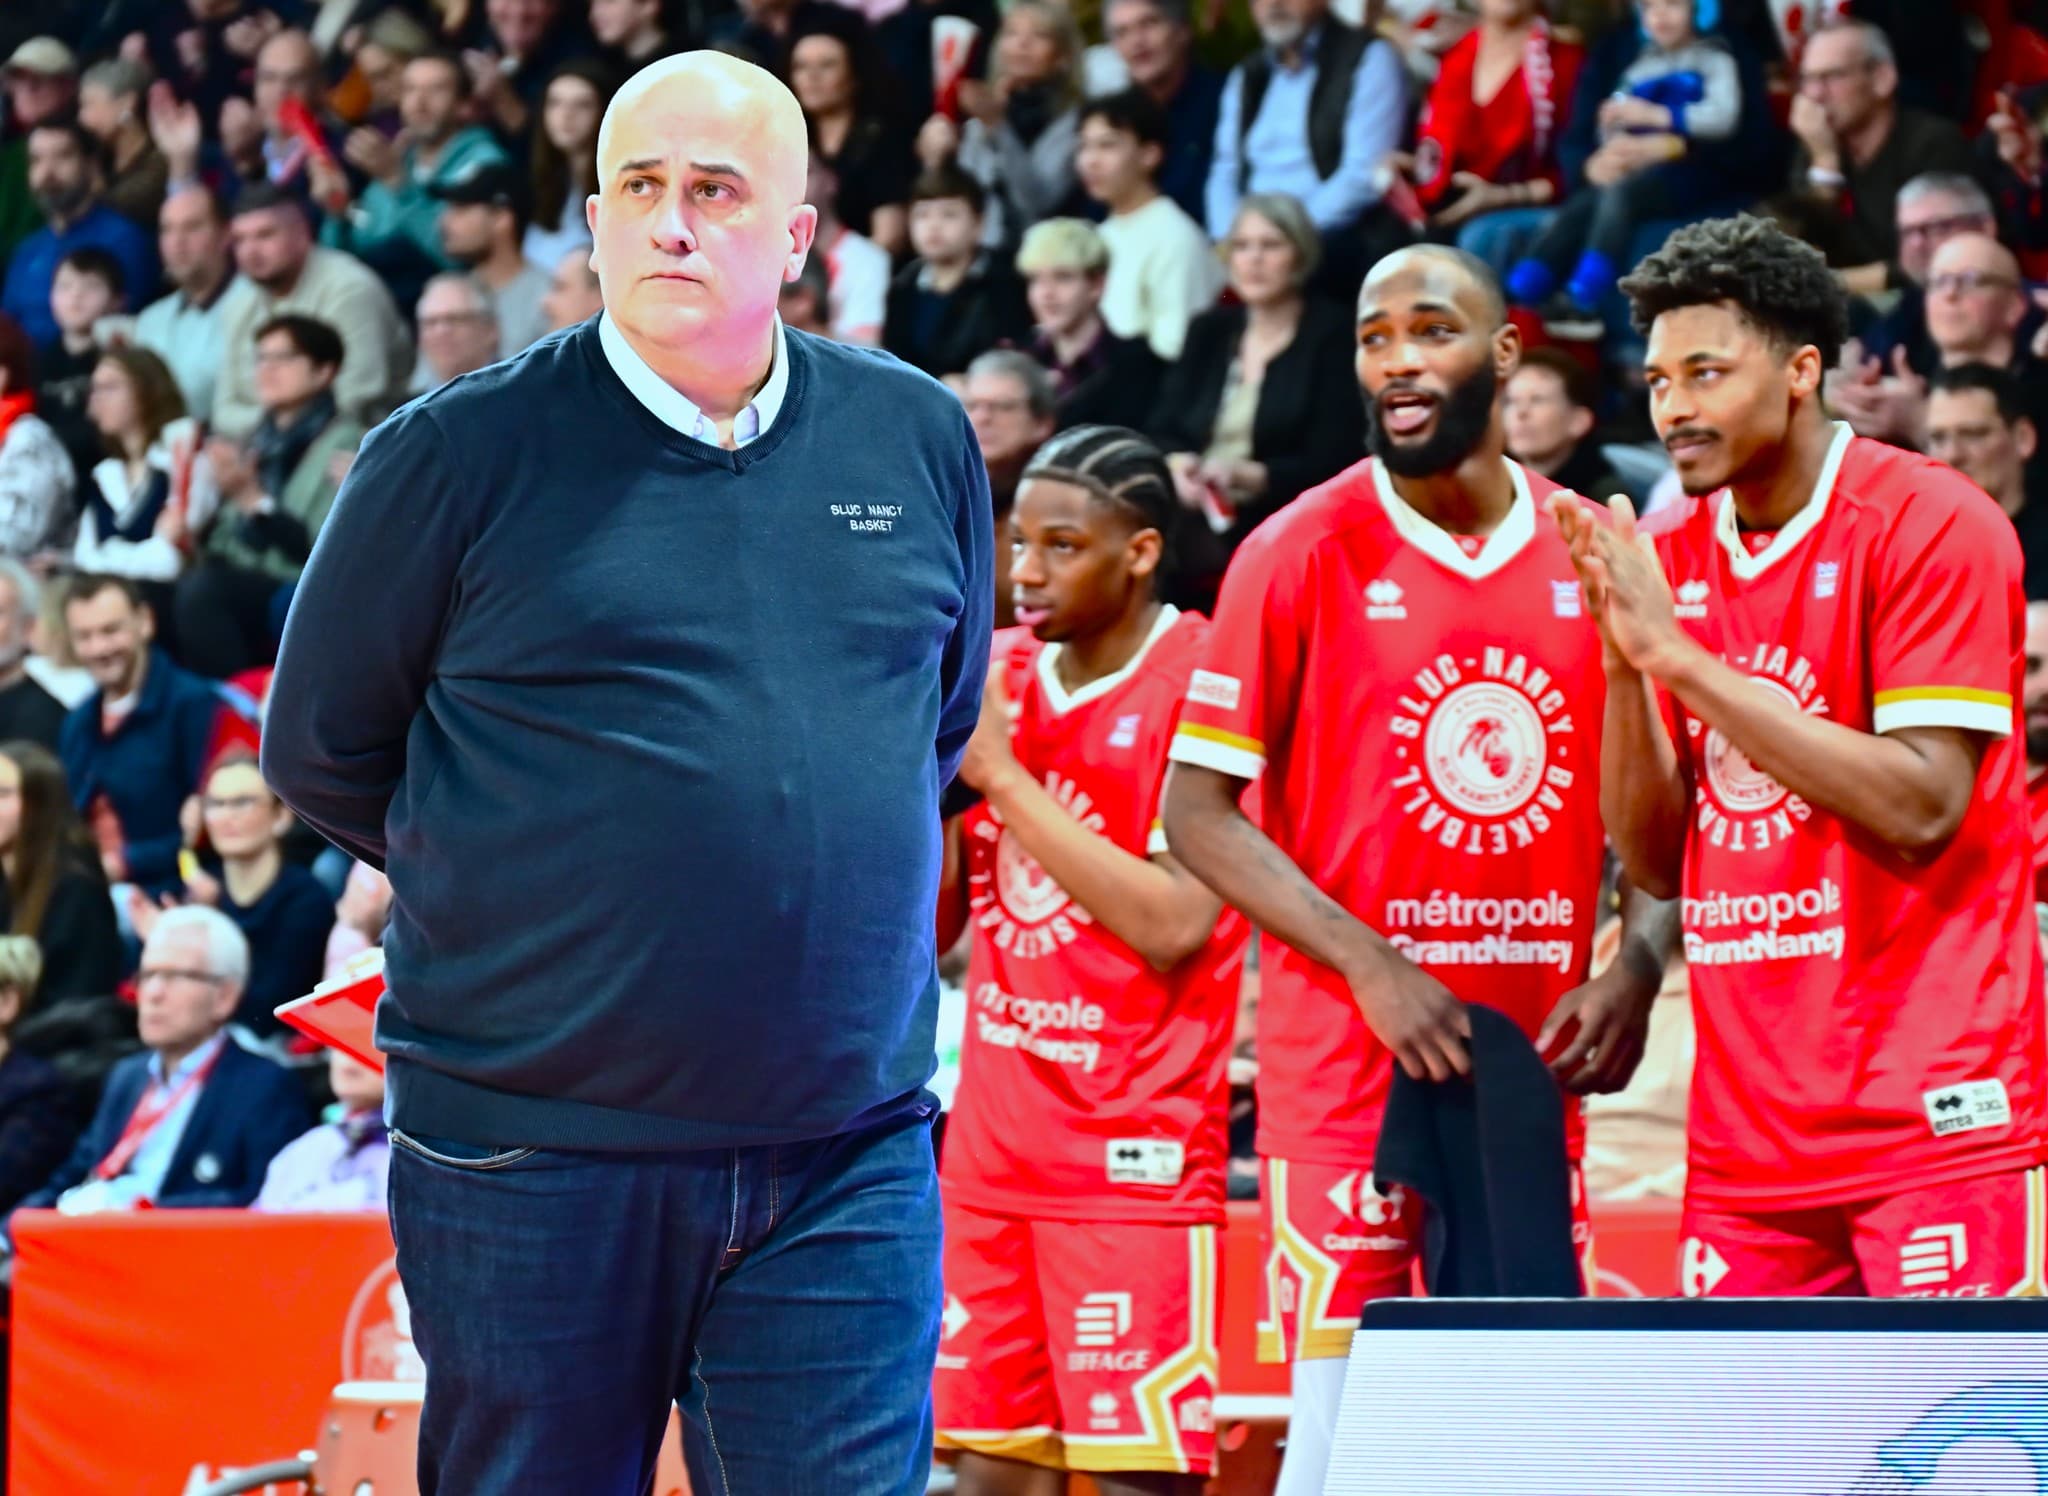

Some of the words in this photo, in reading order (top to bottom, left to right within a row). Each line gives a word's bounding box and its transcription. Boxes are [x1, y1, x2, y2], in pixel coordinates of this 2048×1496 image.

[830, 503, 862, 516] SLUC
[867, 504, 903, 517] NANCY
[849, 519, 893, 532] BASKET
[1391, 764, 1575, 855] BASKETBALL
[1386, 889, 1575, 934] métropole
